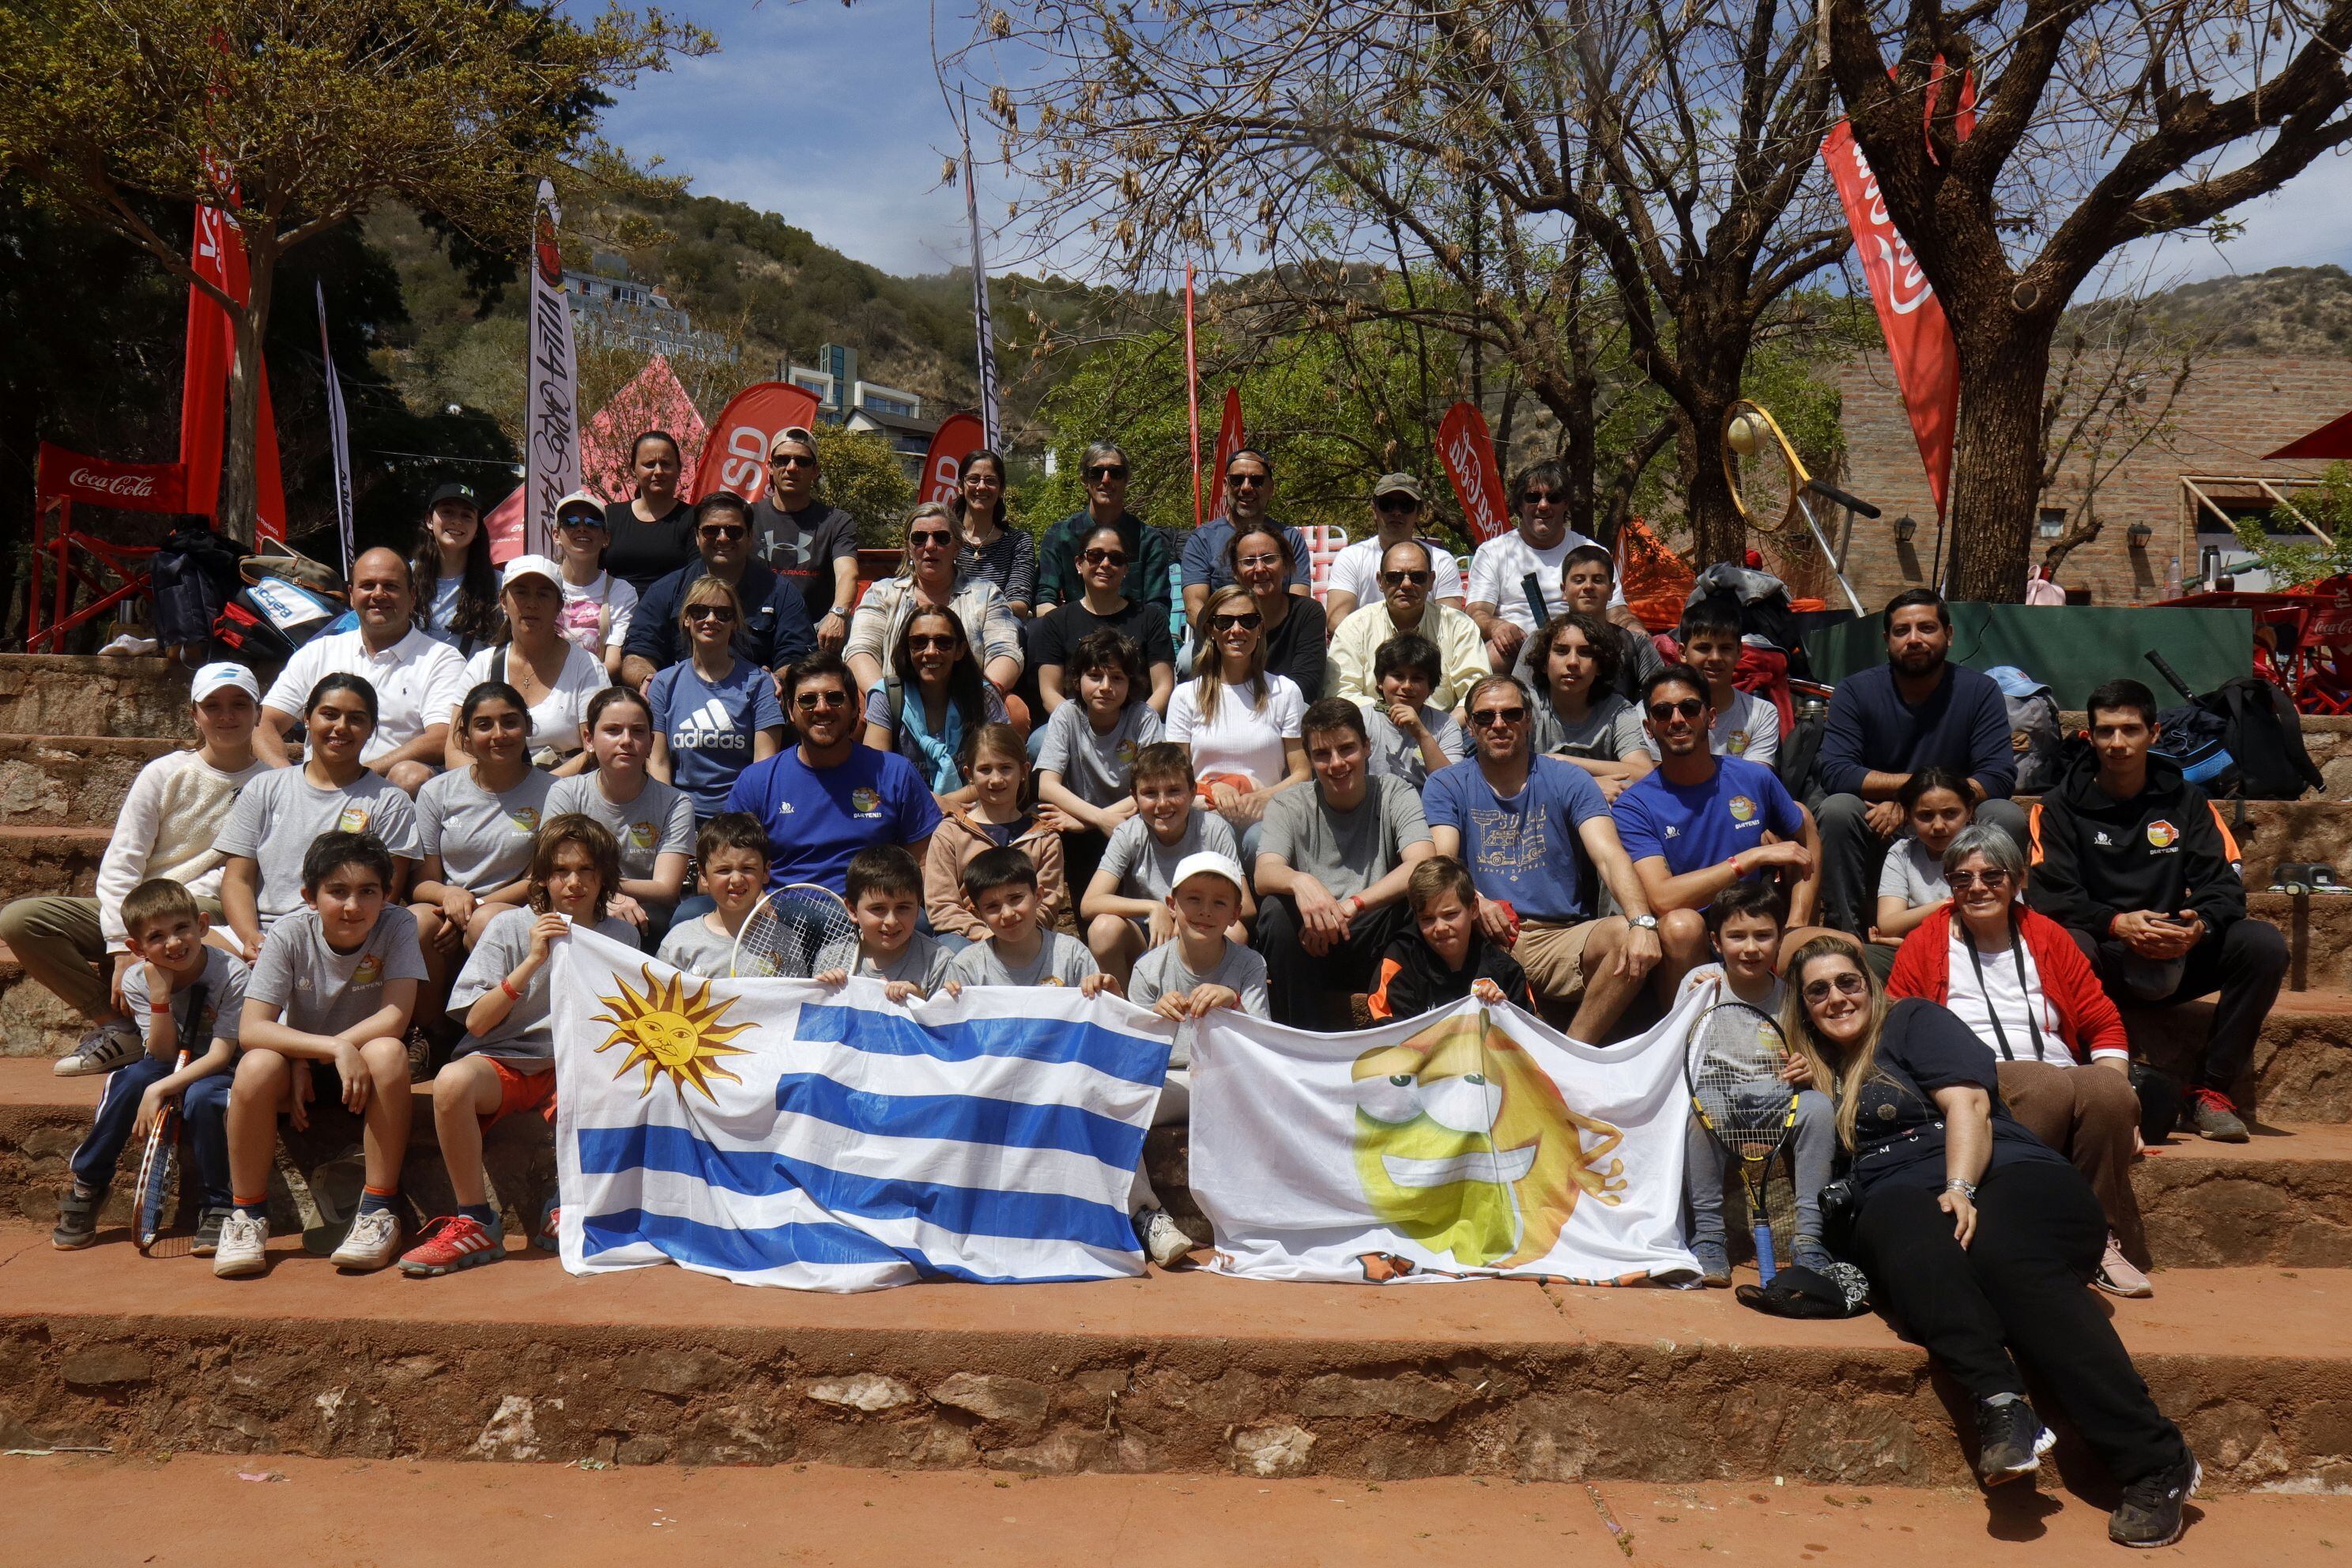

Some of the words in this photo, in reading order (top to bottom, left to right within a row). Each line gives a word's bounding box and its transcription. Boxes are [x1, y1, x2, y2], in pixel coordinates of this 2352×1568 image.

[537, 289, 568, 382] VILLA
[533, 380, 571, 475] CARLOS
[719, 426, 768, 503] SD
[69, 468, 156, 497] Coca-Cola
[673, 728, 745, 749] adidas
